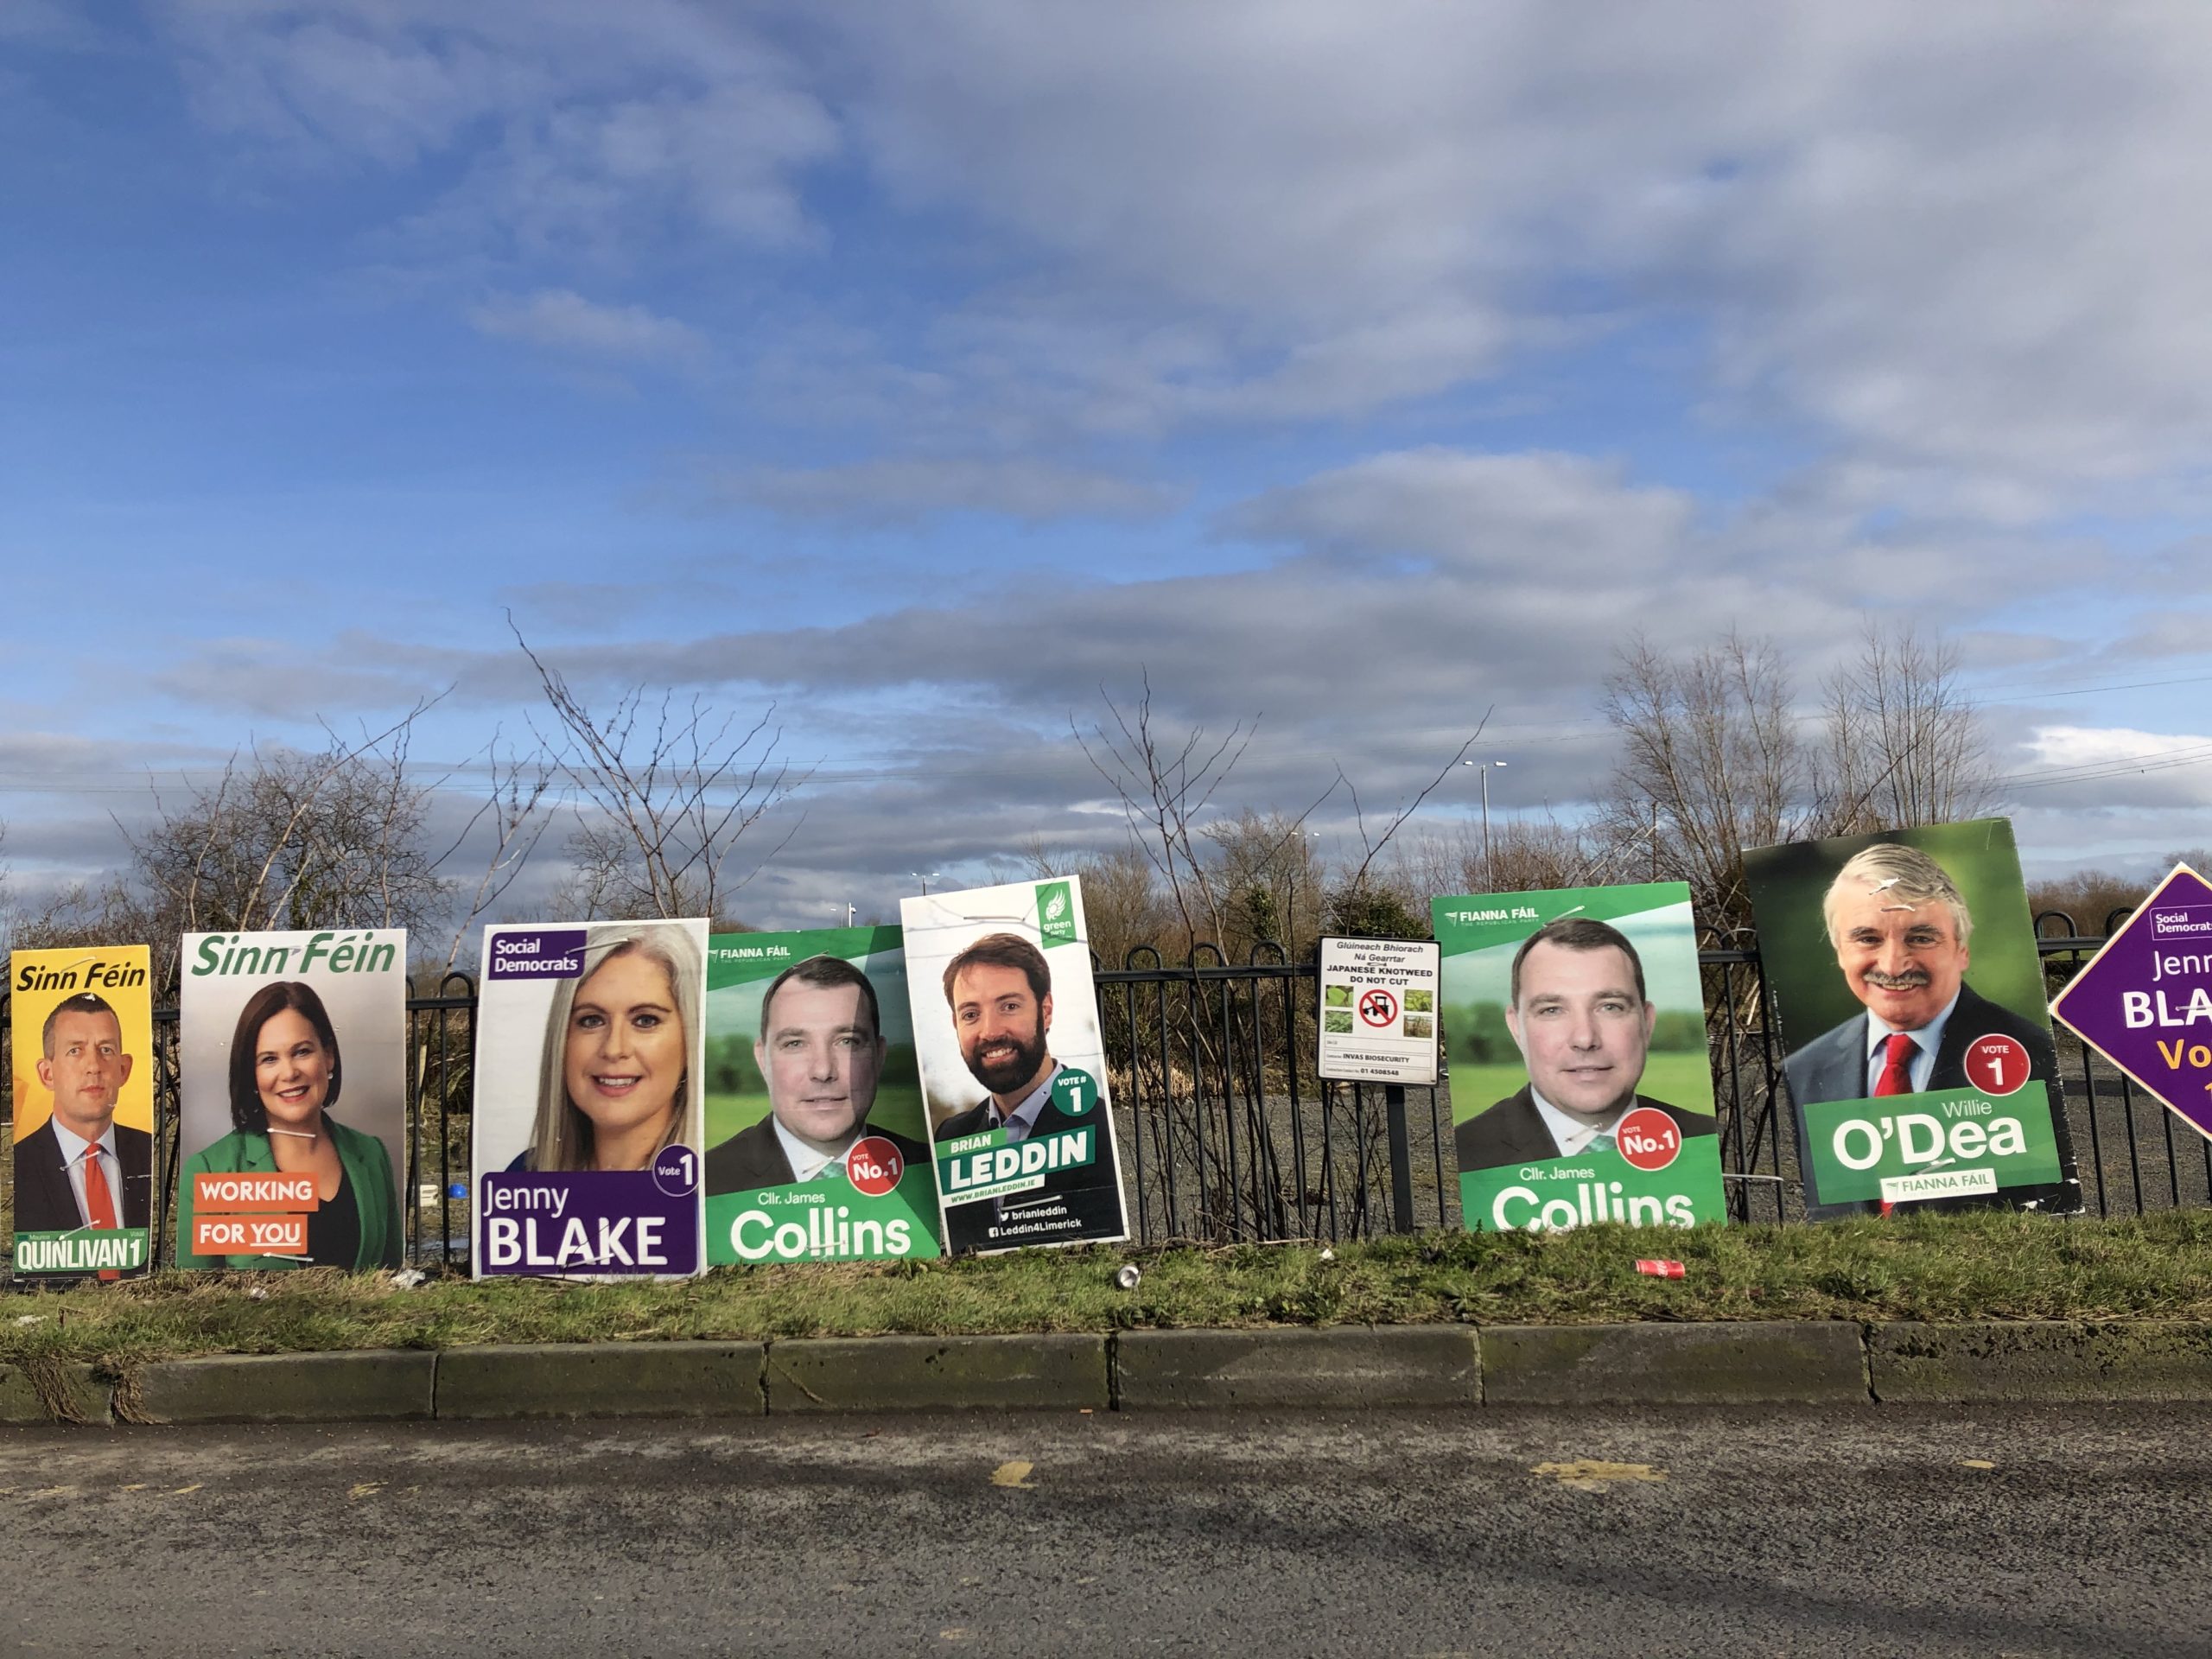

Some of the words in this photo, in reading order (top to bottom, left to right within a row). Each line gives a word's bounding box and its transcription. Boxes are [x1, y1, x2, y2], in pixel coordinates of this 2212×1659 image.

[1459, 910, 1509, 922] FIANNA
[1511, 906, 1540, 918] FÁIL
[2156, 912, 2188, 924] Social
[1044, 921, 1071, 932] green
[191, 935, 289, 976] Sinn
[299, 931, 395, 974] Féin
[495, 938, 541, 954] Social
[720, 948, 764, 958] FIANNA
[766, 945, 791, 957] FÁIL
[1337, 942, 1381, 950] Glúineach
[1383, 944, 1424, 953] Bhiorach
[494, 957, 578, 972] Democrats
[1369, 954, 1405, 963] Gearrtar
[16, 965, 77, 991] Sinn
[84, 963, 145, 988] Féin
[1326, 964, 1376, 974] JAPANESE
[1378, 967, 1433, 976] KNOTWEED
[1365, 1054, 1409, 1064] BIOSECURITY
[1982, 1045, 2010, 1054] VOTE
[1058, 1077, 1079, 1086] VOTE
[1987, 1058, 2004, 1086] 1
[1070, 1087, 1082, 1113] 1
[1942, 1099, 1992, 1118] Willie
[950, 1134, 992, 1154] BRIAN
[1624, 1130, 1675, 1155] No.1
[1833, 1114, 2027, 1170] O'Dea
[852, 1153, 869, 1161] VOTE
[950, 1130, 1087, 1191] LEDDIN
[658, 1166, 680, 1175] Vote
[679, 1154, 693, 1185] 1
[853, 1157, 898, 1181] No.1
[1519, 1167, 1547, 1180] Cllr.
[1549, 1166, 1595, 1179] James
[200, 1181, 312, 1201] WORKING
[950, 1179, 1035, 1203] WWW.BRIANLEDDIN.IE
[1902, 1177, 1958, 1192] FIANNA
[1961, 1173, 1990, 1186] FÁIL
[483, 1180, 569, 1217] Jenny
[758, 1192, 781, 1205] Cllr.
[785, 1192, 825, 1205] James
[1493, 1181, 1695, 1232] Collins
[1012, 1205, 1067, 1221] brianleddin
[200, 1224, 244, 1244] FOR
[251, 1222, 301, 1243] YOU
[730, 1206, 912, 1259] Collins
[1000, 1218, 1082, 1236] Leddin4Limerick
[489, 1217, 667, 1266] BLAKE
[17, 1238, 127, 1270] QUINLIVAN
[130, 1239, 140, 1266] 1
